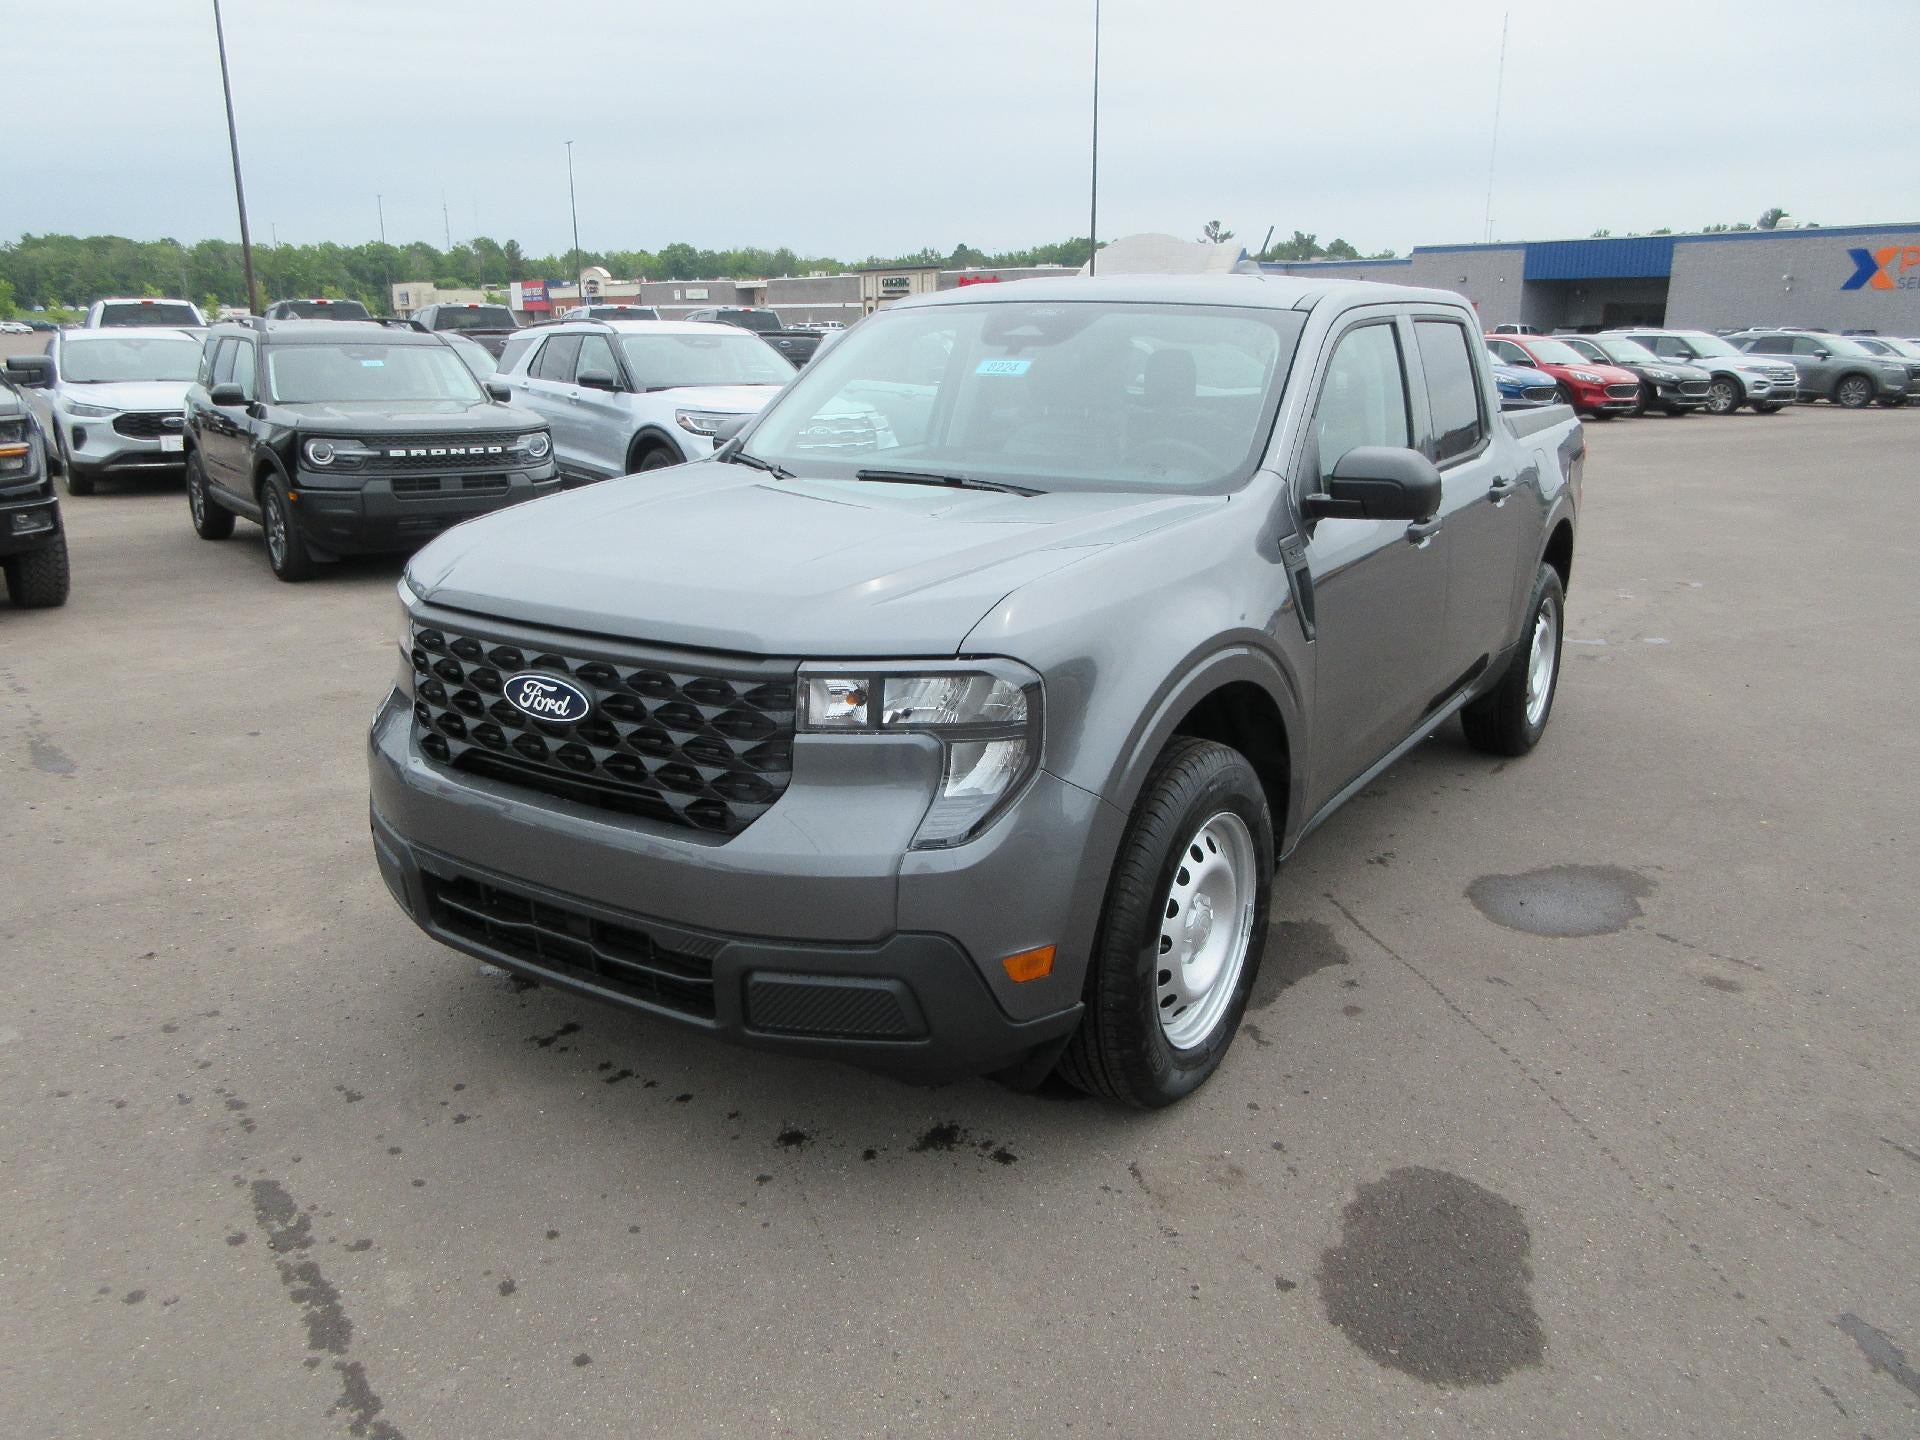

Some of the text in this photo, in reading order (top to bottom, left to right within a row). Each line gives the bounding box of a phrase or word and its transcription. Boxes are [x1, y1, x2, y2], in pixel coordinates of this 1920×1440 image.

[1897, 276, 1920, 290] SE
[389, 446, 502, 457] BRONCO
[520, 680, 571, 716] Ford
